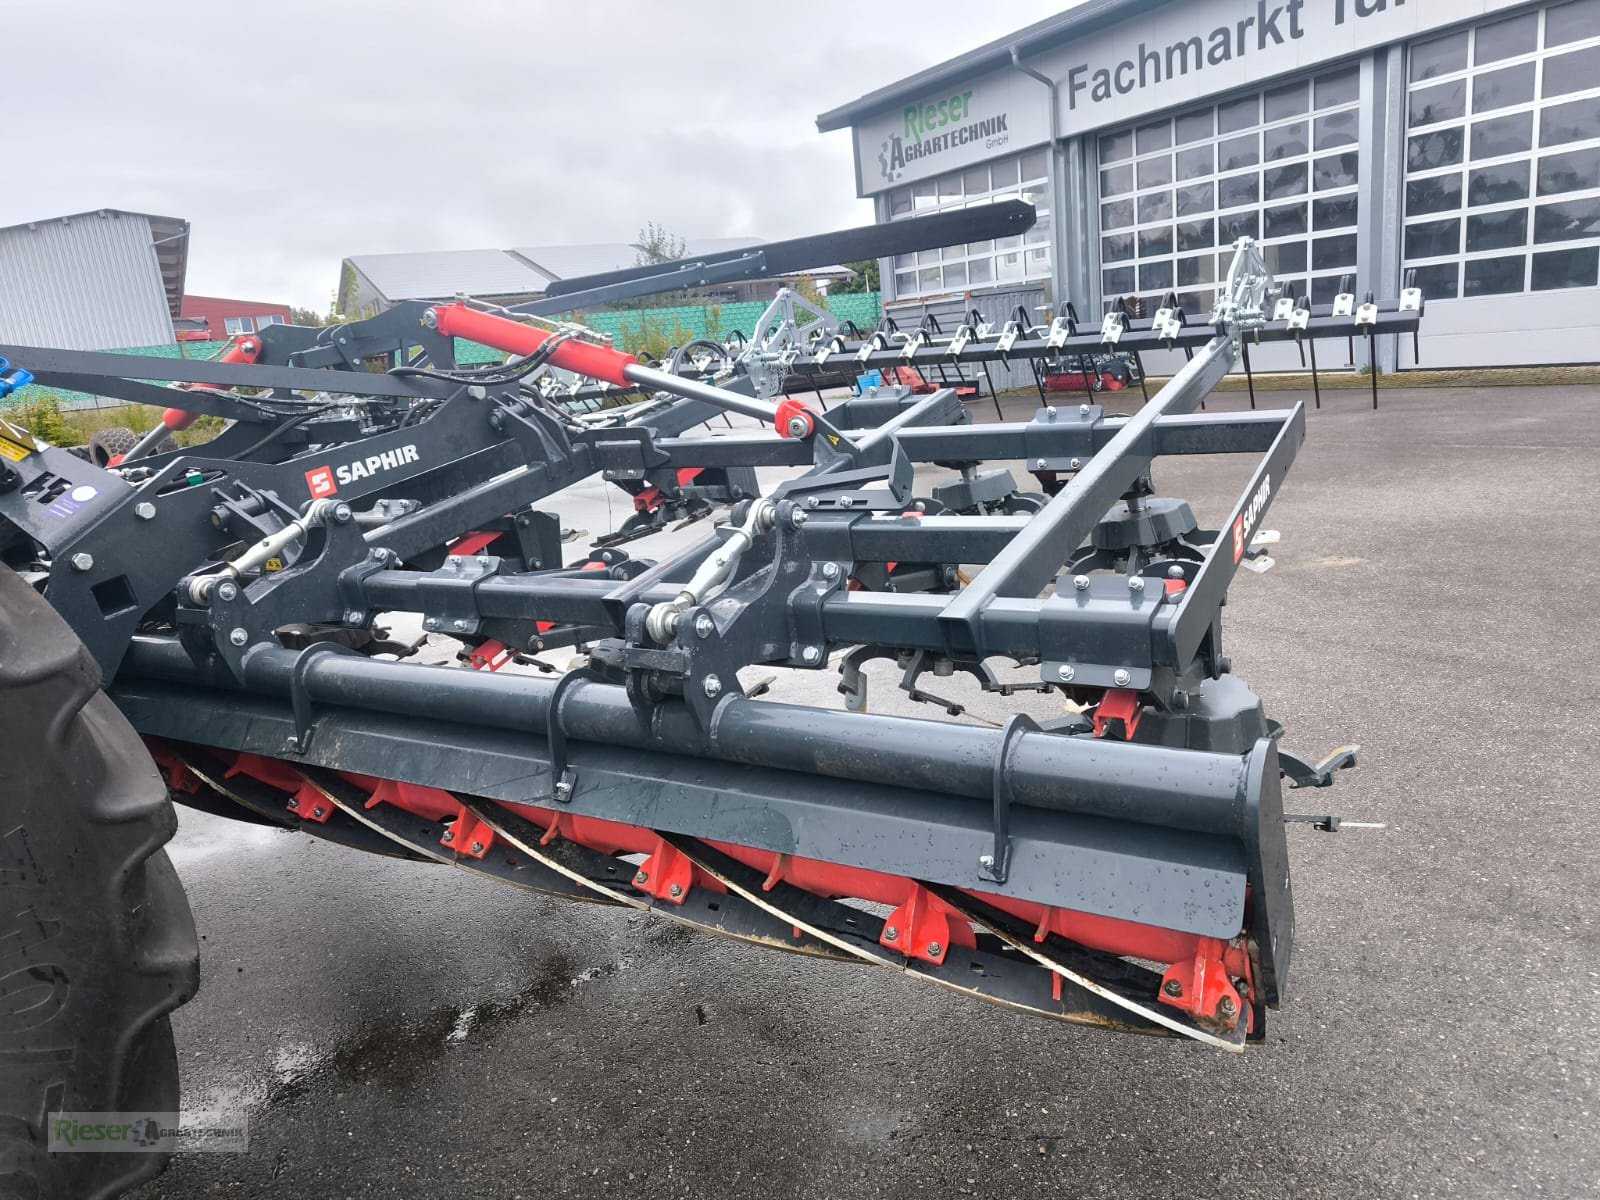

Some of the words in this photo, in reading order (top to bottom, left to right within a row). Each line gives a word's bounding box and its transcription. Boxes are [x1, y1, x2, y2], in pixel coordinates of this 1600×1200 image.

[1068, 0, 1304, 110] Fachmarkt
[890, 113, 1008, 171] AGRARTECHNIK
[985, 134, 1009, 149] GmbH
[336, 444, 420, 485] SAPHIR
[1243, 473, 1270, 539] SAPHIR
